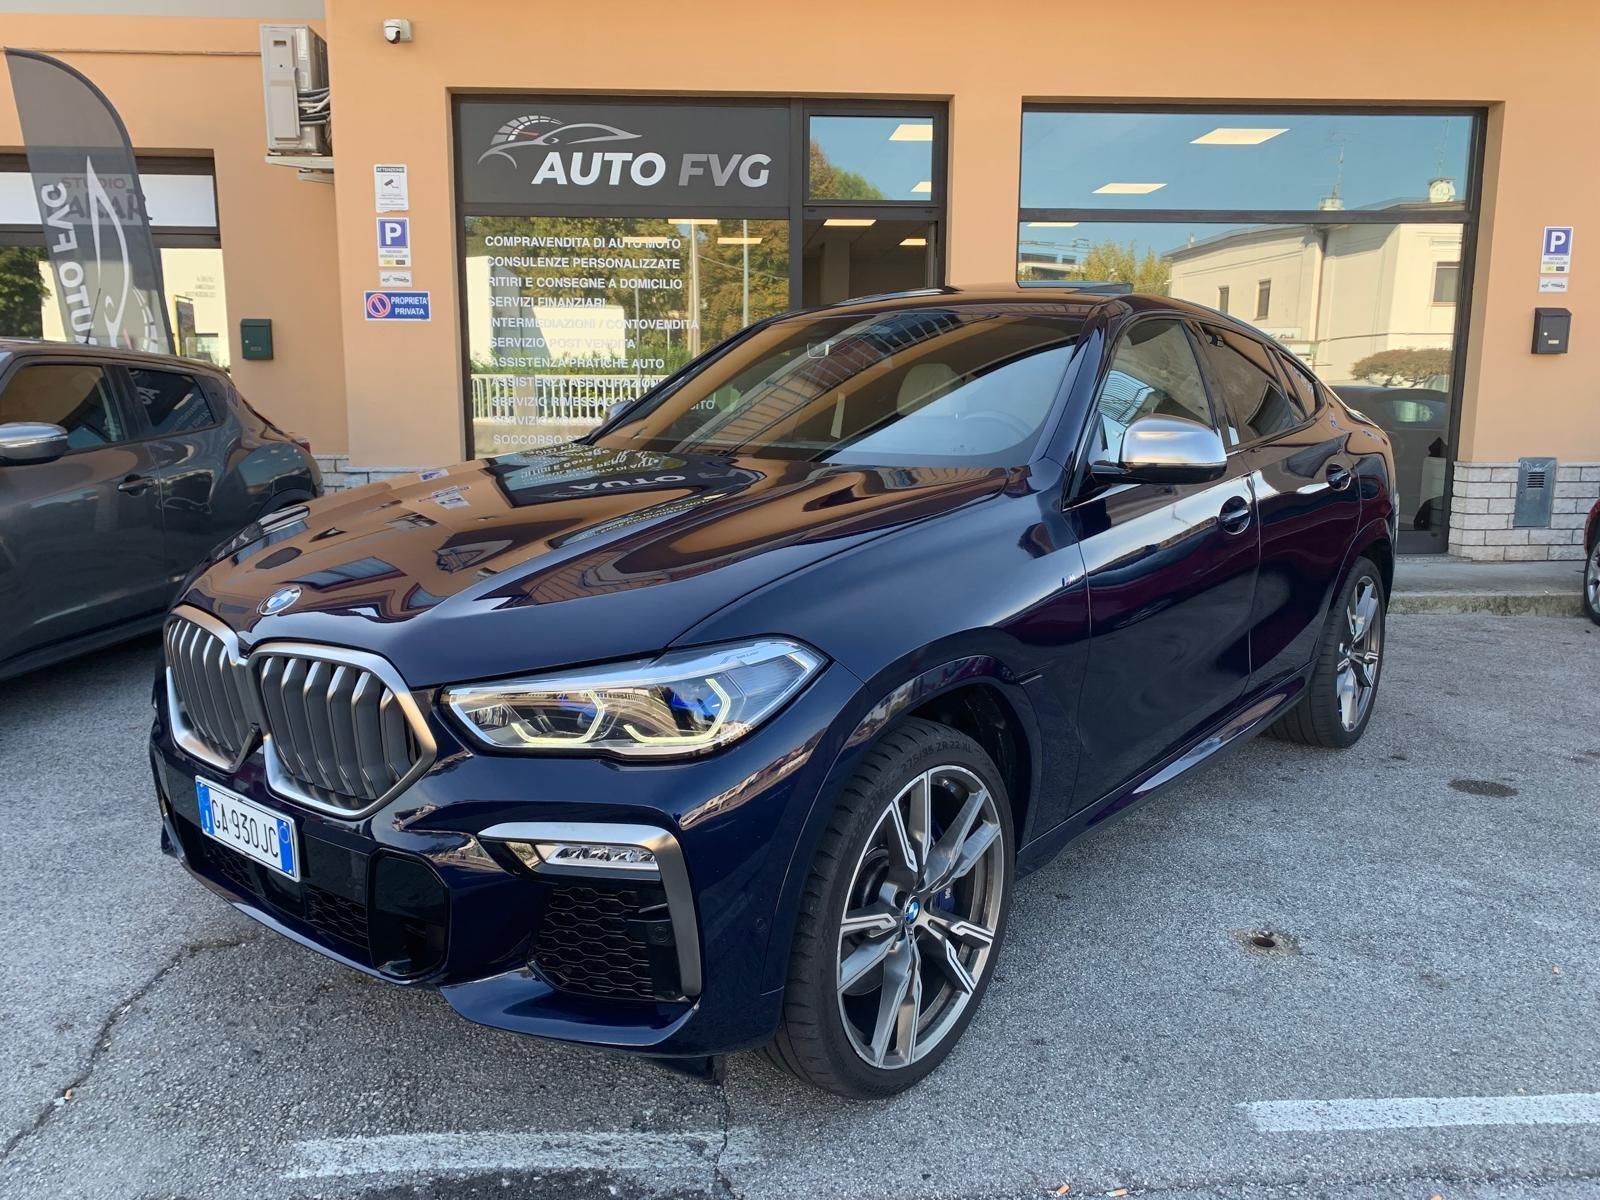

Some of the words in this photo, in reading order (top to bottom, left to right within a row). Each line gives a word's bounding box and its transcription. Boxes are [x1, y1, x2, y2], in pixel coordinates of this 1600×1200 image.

[531, 151, 666, 186] AUTO
[678, 153, 772, 188] FVG
[385, 223, 401, 244] P
[485, 236, 590, 248] COMPRAVENDITA
[593, 238, 605, 248] DI
[608, 238, 642, 249] AUTO
[645, 238, 681, 249] MOTO
[1550, 231, 1566, 252] P
[487, 256, 569, 268] CONSULENZE
[573, 258, 680, 270] PERSONALIZZATE
[488, 277, 522, 288] RITIRI
[526, 277, 533, 288] E
[537, 277, 605, 289] CONSEGNE
[608, 278, 617, 289] A
[620, 278, 682, 290] DOMICILIO
[489, 296, 534, 308] SERVIZI
[538, 297, 606, 309] FINANZIARI
[395, 307, 425, 315] PRIVATA
[606, 319, 699, 330] CONTOVENDITA
[489, 337, 545, 348] SERVIZIO
[550, 337, 581, 349] POST
[586, 338, 636, 349] VENDITA
[490, 357, 567, 368] ASSISTENZA
[569, 358, 629, 369] PRATICHE
[632, 358, 665, 370] AUTO
[491, 376, 567, 388] ASSISTENZA
[491, 396, 547, 407] SERVIZIO
[493, 433, 562, 445] SOCCORSO
